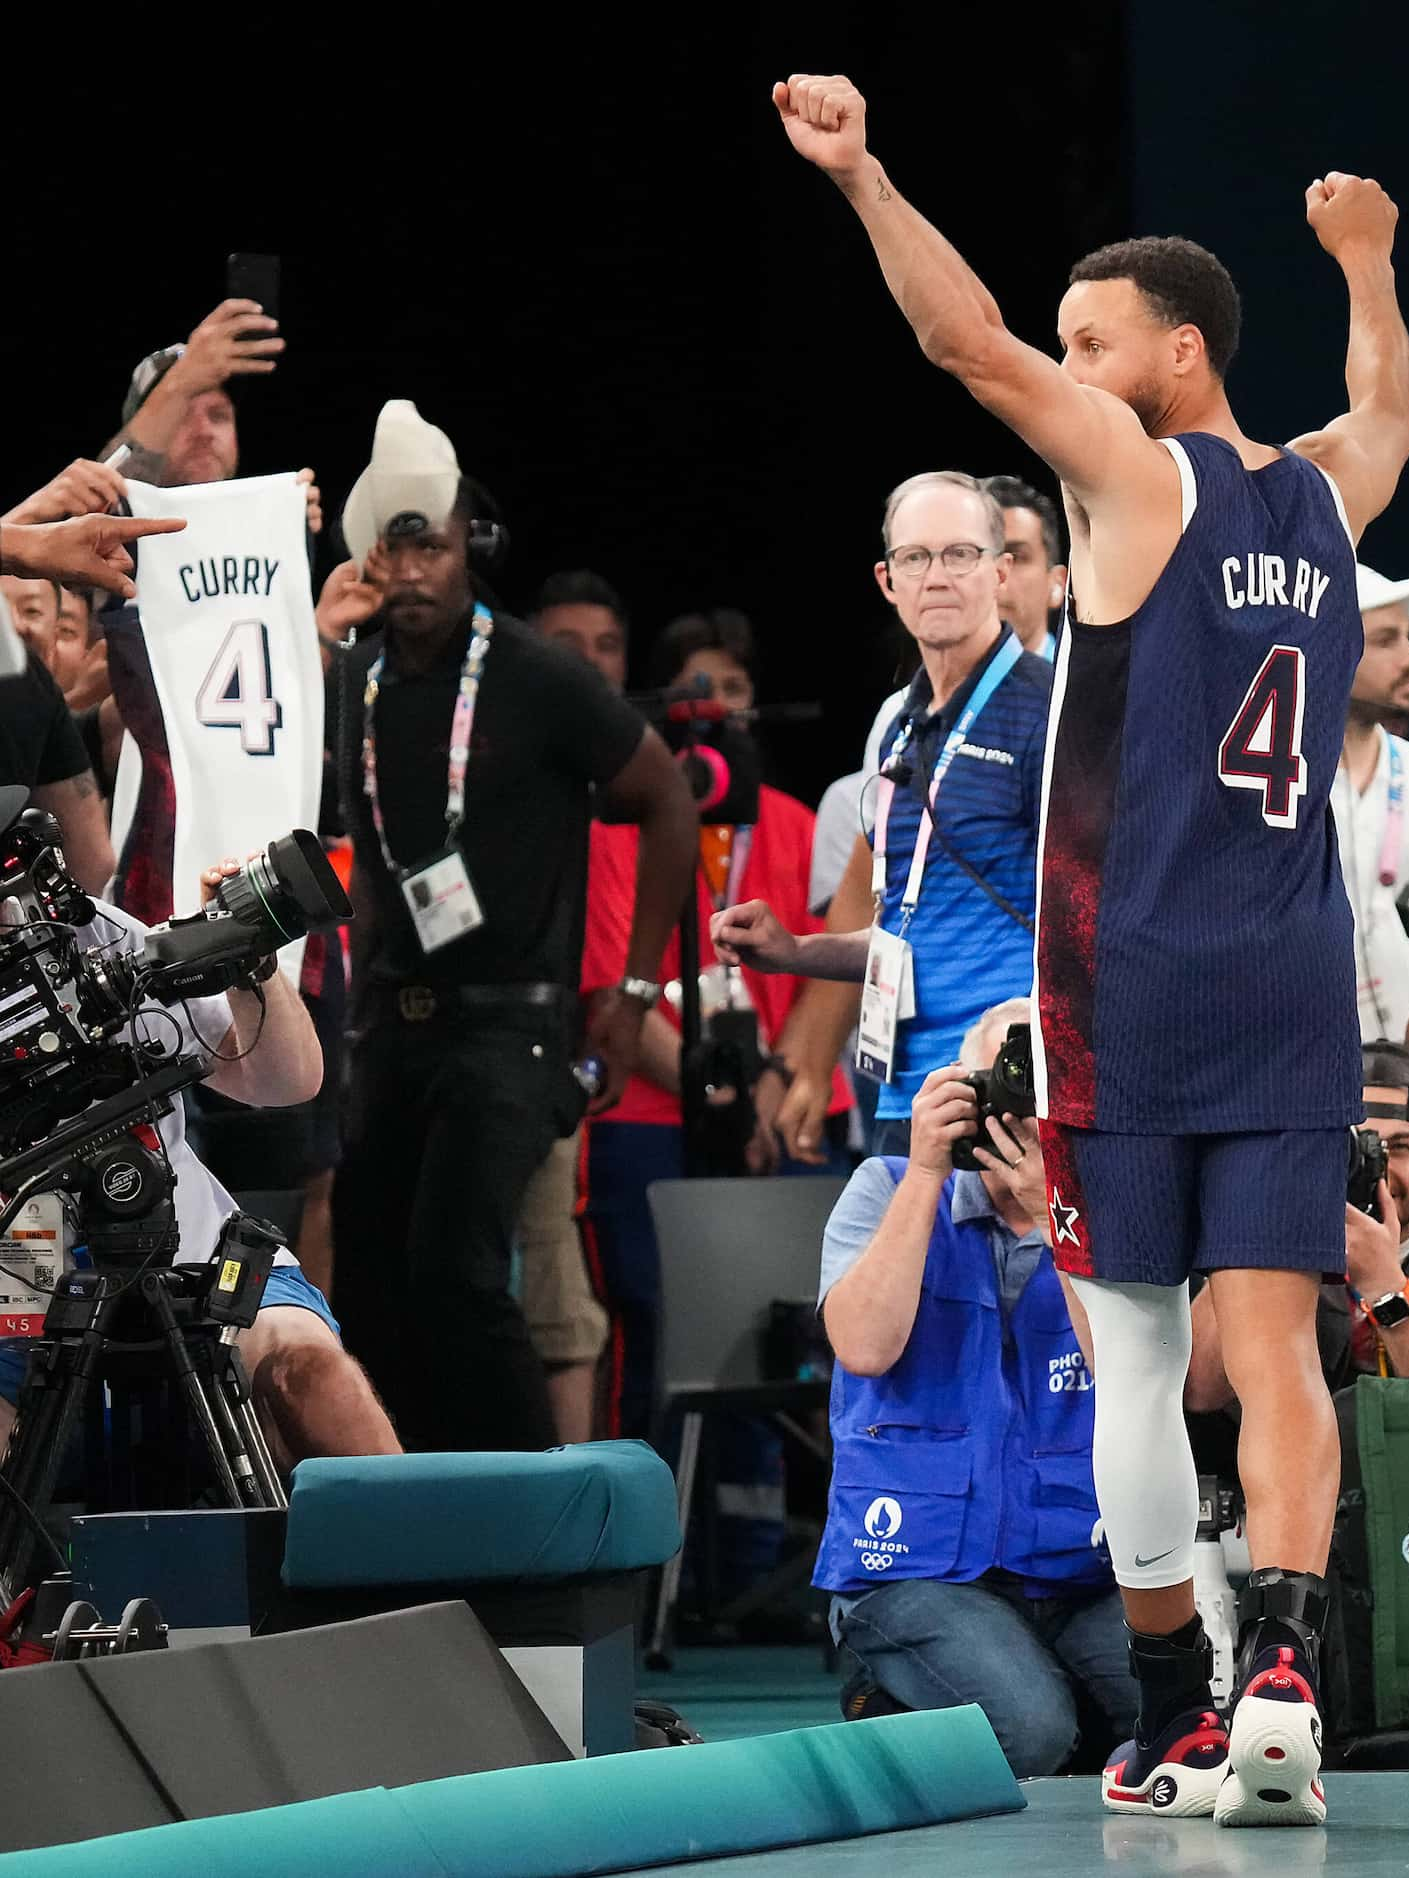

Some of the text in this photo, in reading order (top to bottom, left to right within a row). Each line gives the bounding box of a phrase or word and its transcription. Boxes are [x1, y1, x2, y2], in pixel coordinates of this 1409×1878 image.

[179, 557, 279, 602] CURRY
[1222, 553, 1330, 619] CURRY
[195, 617, 283, 756] 4
[1217, 644, 1308, 829] 4
[172, 973, 204, 985] Canon
[1049, 1351, 1083, 1374] PHO
[1049, 1369, 1095, 1393] 021
[853, 1537, 909, 1554] PARIS 2024
